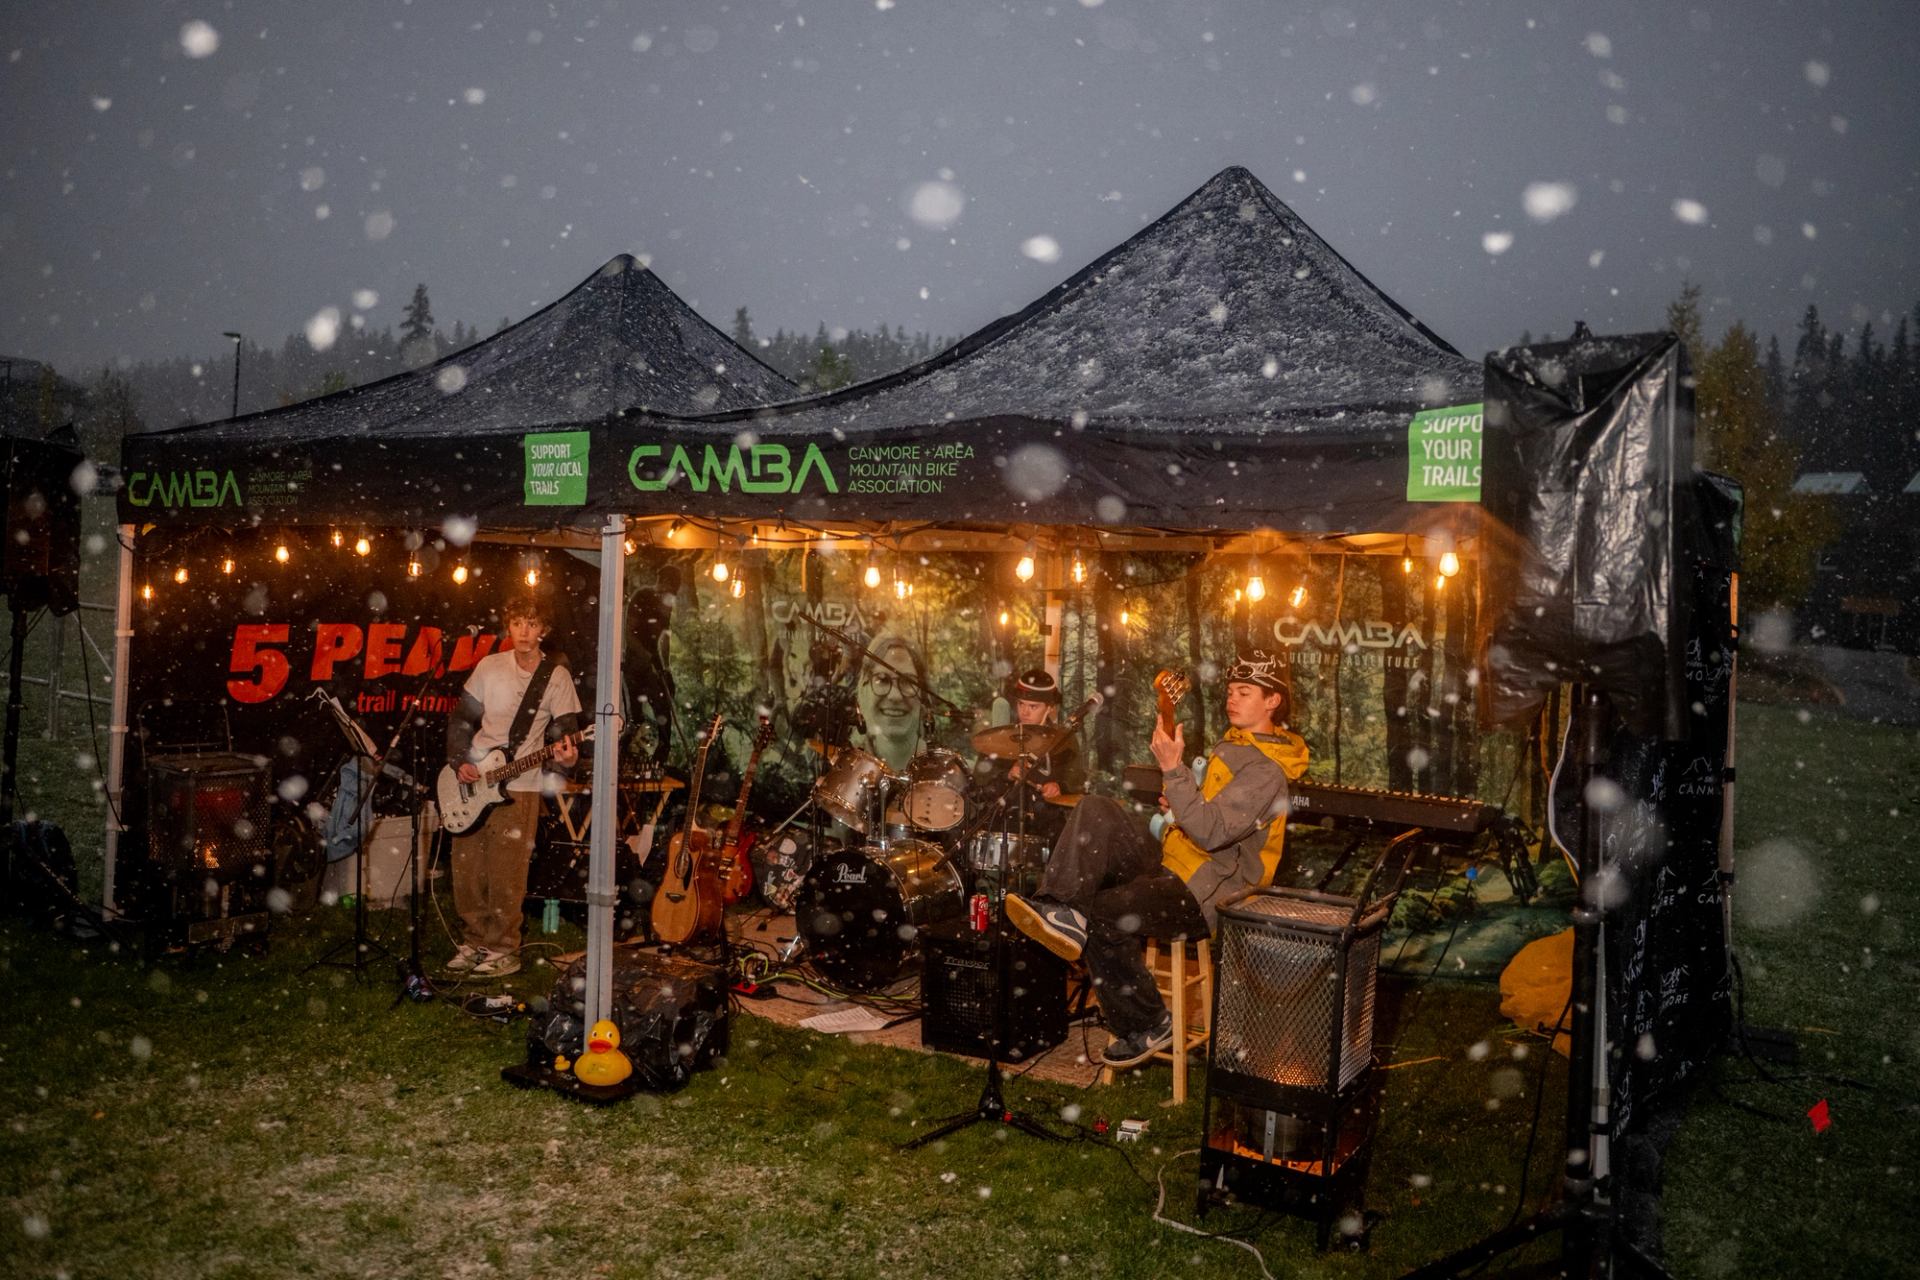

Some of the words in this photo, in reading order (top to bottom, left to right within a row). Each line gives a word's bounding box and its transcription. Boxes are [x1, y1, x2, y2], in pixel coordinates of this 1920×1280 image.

[531, 444, 571, 459] SUPPORT
[848, 446, 920, 460] CANMORE
[933, 445, 975, 459] AREA
[1422, 439, 1473, 460] YOUR
[532, 462, 555, 477] YOUR
[555, 462, 583, 477] LOCAL
[628, 442, 839, 493] CAMBA
[849, 463, 922, 477] MOUNTAIN
[926, 462, 958, 476] BIKE
[1422, 465, 1482, 487] TRAILS
[128, 470, 243, 507] CAMBA
[530, 480, 560, 495] TRAILS
[848, 480, 942, 493] ASSOCIATION
[771, 601, 867, 628] CAMBA
[1274, 616, 1428, 650] CAMBA
[226, 624, 290, 704] 5
[1346, 655, 1420, 669] ADVENTURE
[357, 690, 396, 713] trail
[1291, 795, 1310, 808] AHA
[832, 862, 867, 884] Pearl
